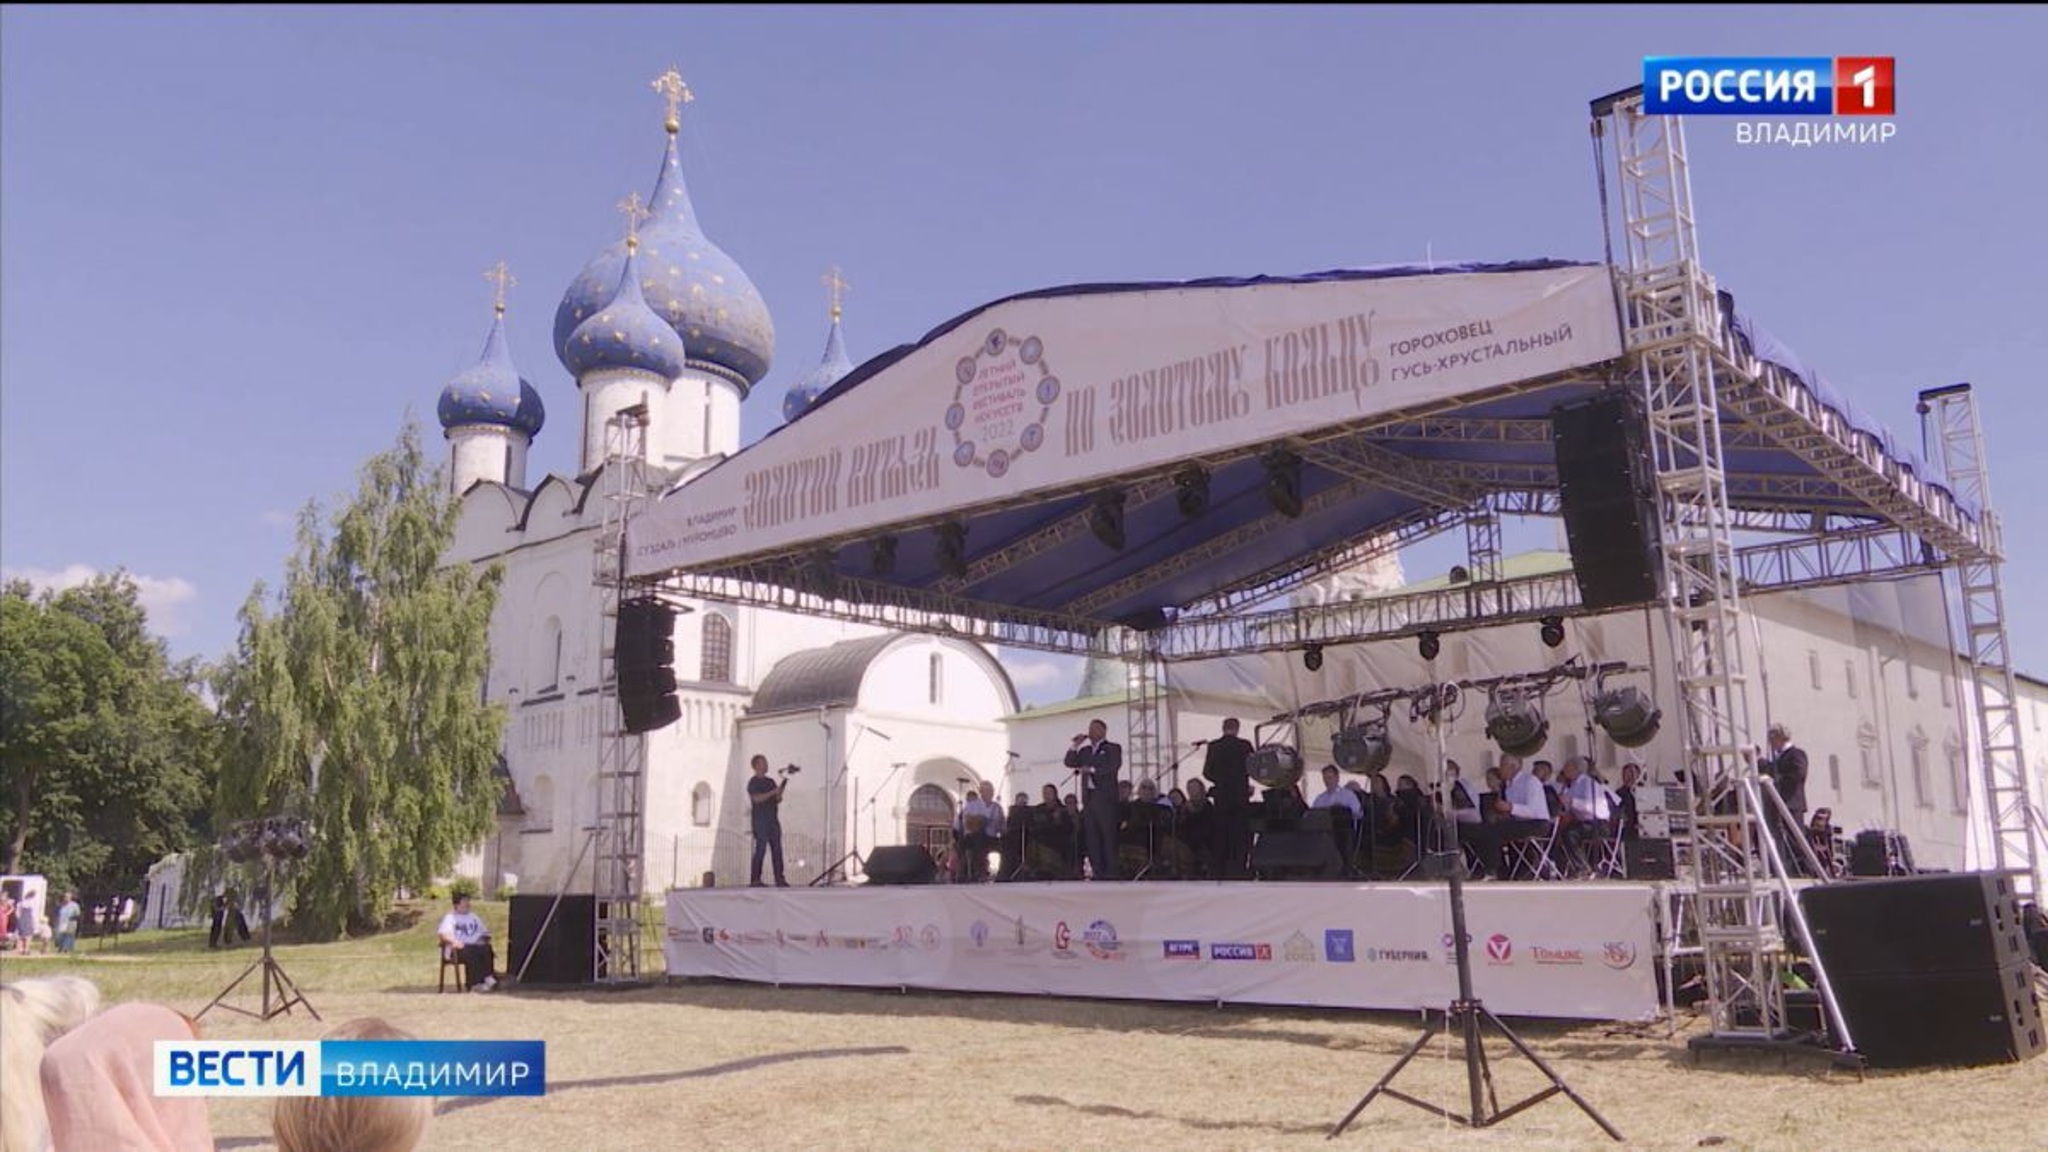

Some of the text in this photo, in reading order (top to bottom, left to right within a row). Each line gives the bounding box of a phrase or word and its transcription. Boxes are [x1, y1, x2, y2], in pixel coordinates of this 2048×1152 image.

[1389, 320, 1494, 357] ГОРОХОВЕЦ
[1390, 320, 1574, 382] ГУСЬ-ХРУСТАЛЬНЫЙ
[981, 419, 1015, 443] 2022
[1213, 946, 1255, 958] РОССИЯ
